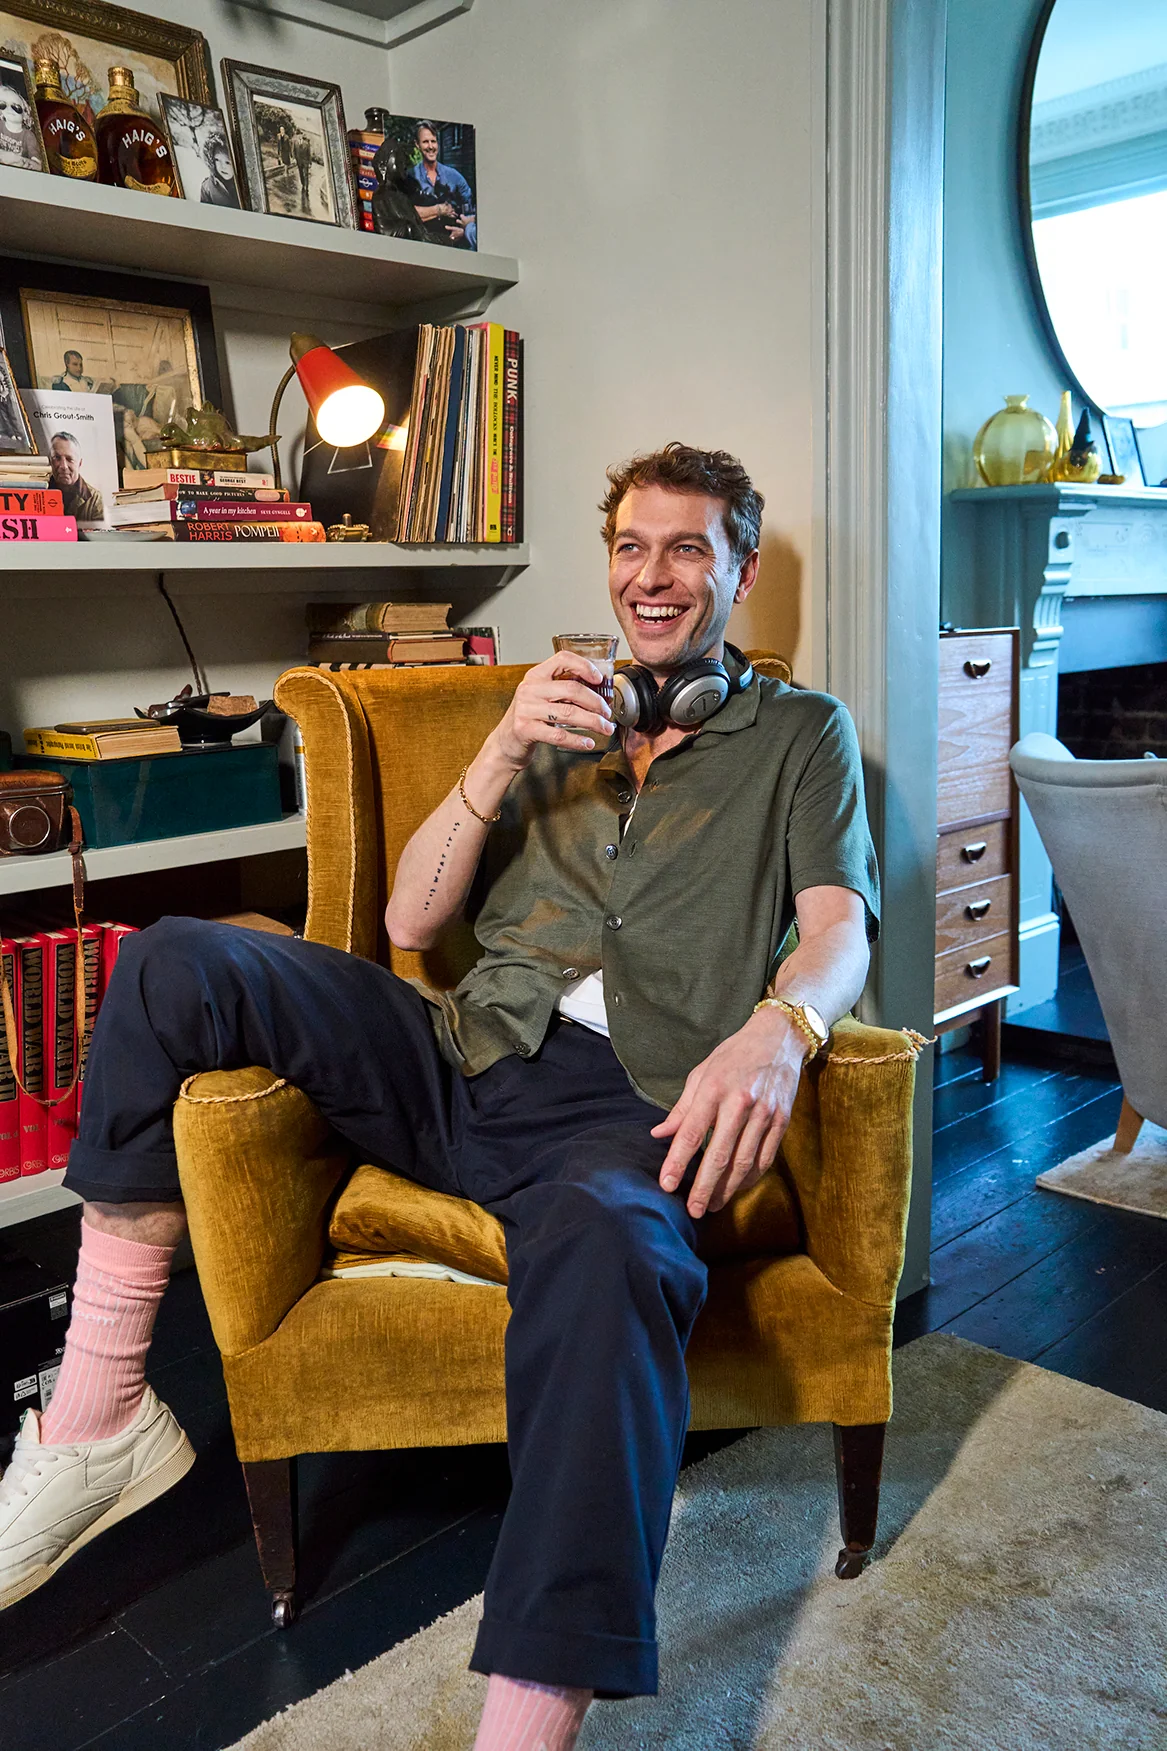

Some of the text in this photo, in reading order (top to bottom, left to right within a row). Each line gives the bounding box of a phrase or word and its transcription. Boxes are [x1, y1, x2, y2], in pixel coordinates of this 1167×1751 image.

[49, 118, 85, 142] HAIG'S
[122, 129, 168, 158] HAIG'S
[33, 411, 94, 421] Chris Grout-Smith
[170, 474, 196, 483] BESTIE
[237, 507, 257, 515] kitchen
[0, 519, 39, 539] SH
[187, 522, 229, 531] ROBERT
[189, 531, 233, 541] HARRIS
[234, 525, 280, 538] POMPEII
[433, 853, 446, 883] WHAT
[84, 940, 100, 1012] WORLD
[24, 950, 42, 1092] WORLD WAR II
[57, 945, 74, 1087] WORLD WAR II
